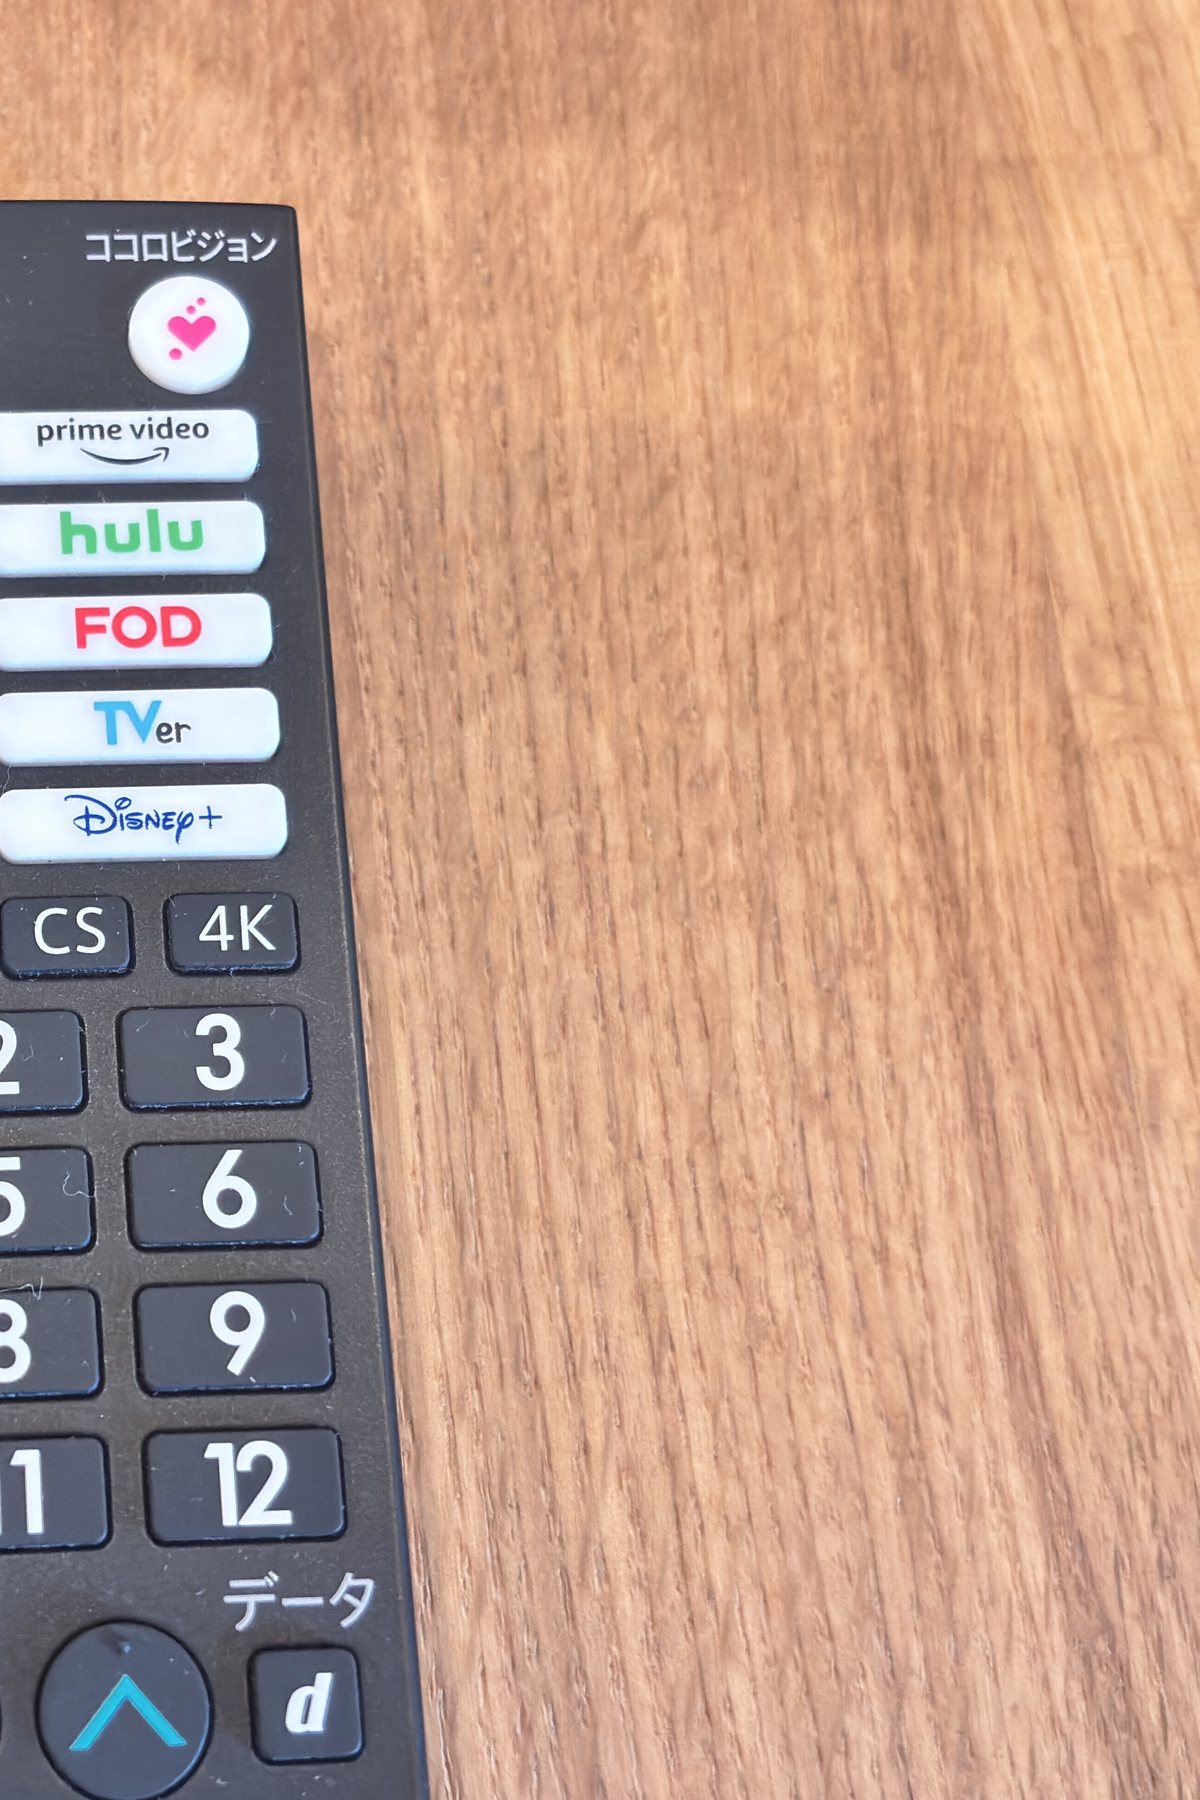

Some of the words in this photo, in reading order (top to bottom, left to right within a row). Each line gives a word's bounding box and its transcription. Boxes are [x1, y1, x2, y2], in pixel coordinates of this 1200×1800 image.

[85, 231, 277, 264] ココロビジョン
[37, 419, 122, 446] prime
[130, 417, 209, 440] video
[60, 510, 204, 555] hulu
[75, 606, 201, 649] FOD
[94, 701, 191, 746] TVer
[34, 907, 106, 955] CS
[199, 905, 276, 952] 4K
[196, 1013, 246, 1091] 3
[202, 1149, 257, 1229] 6
[210, 1290, 266, 1376] 9
[204, 1440, 293, 1527] 12
[224, 1572, 376, 1631] データ
[286, 1672, 332, 1734] d
